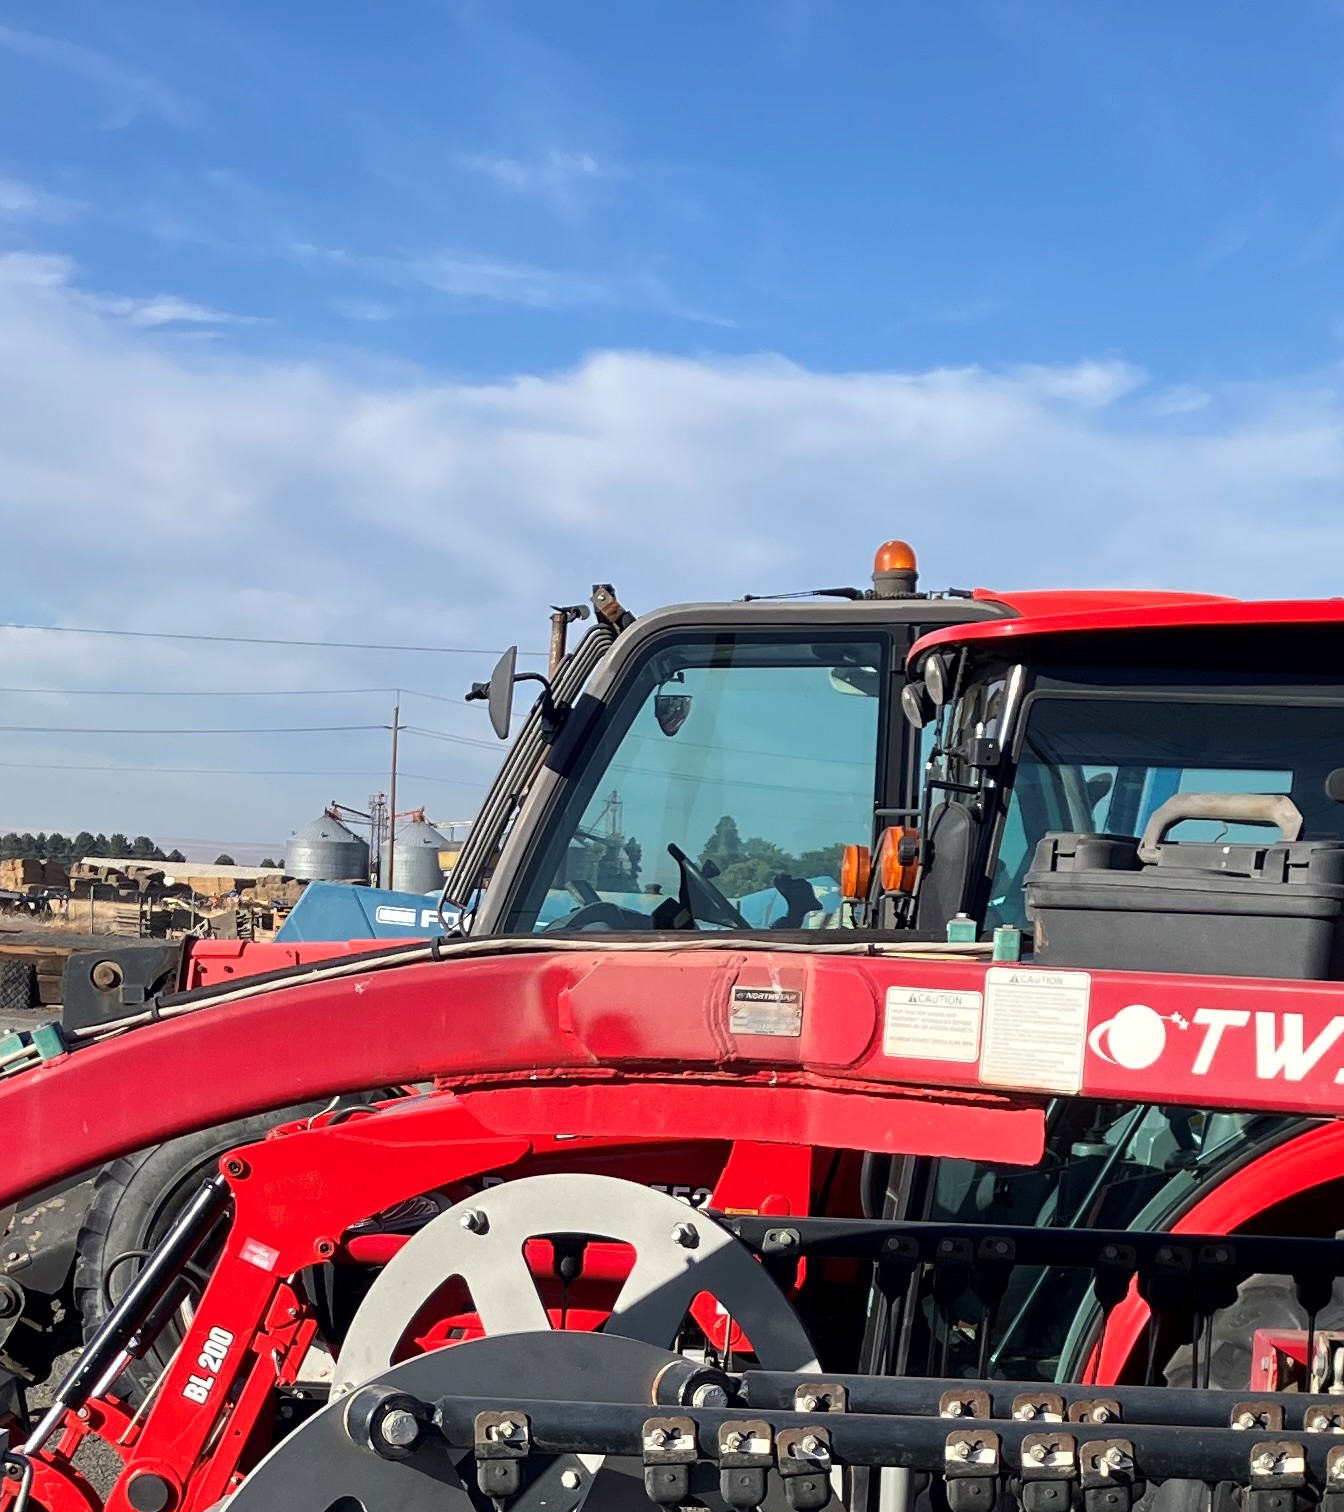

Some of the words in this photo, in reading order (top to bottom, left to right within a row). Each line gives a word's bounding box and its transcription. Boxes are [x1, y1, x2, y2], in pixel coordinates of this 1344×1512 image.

[1020, 975, 1064, 986] CAUTION
[745, 992, 797, 1001] NORTHSTAR
[918, 994, 962, 1006] CAUTION
[650, 1184, 713, 1209] 52
[197, 1326, 234, 1374] 200
[182, 1374, 215, 1404] BL
